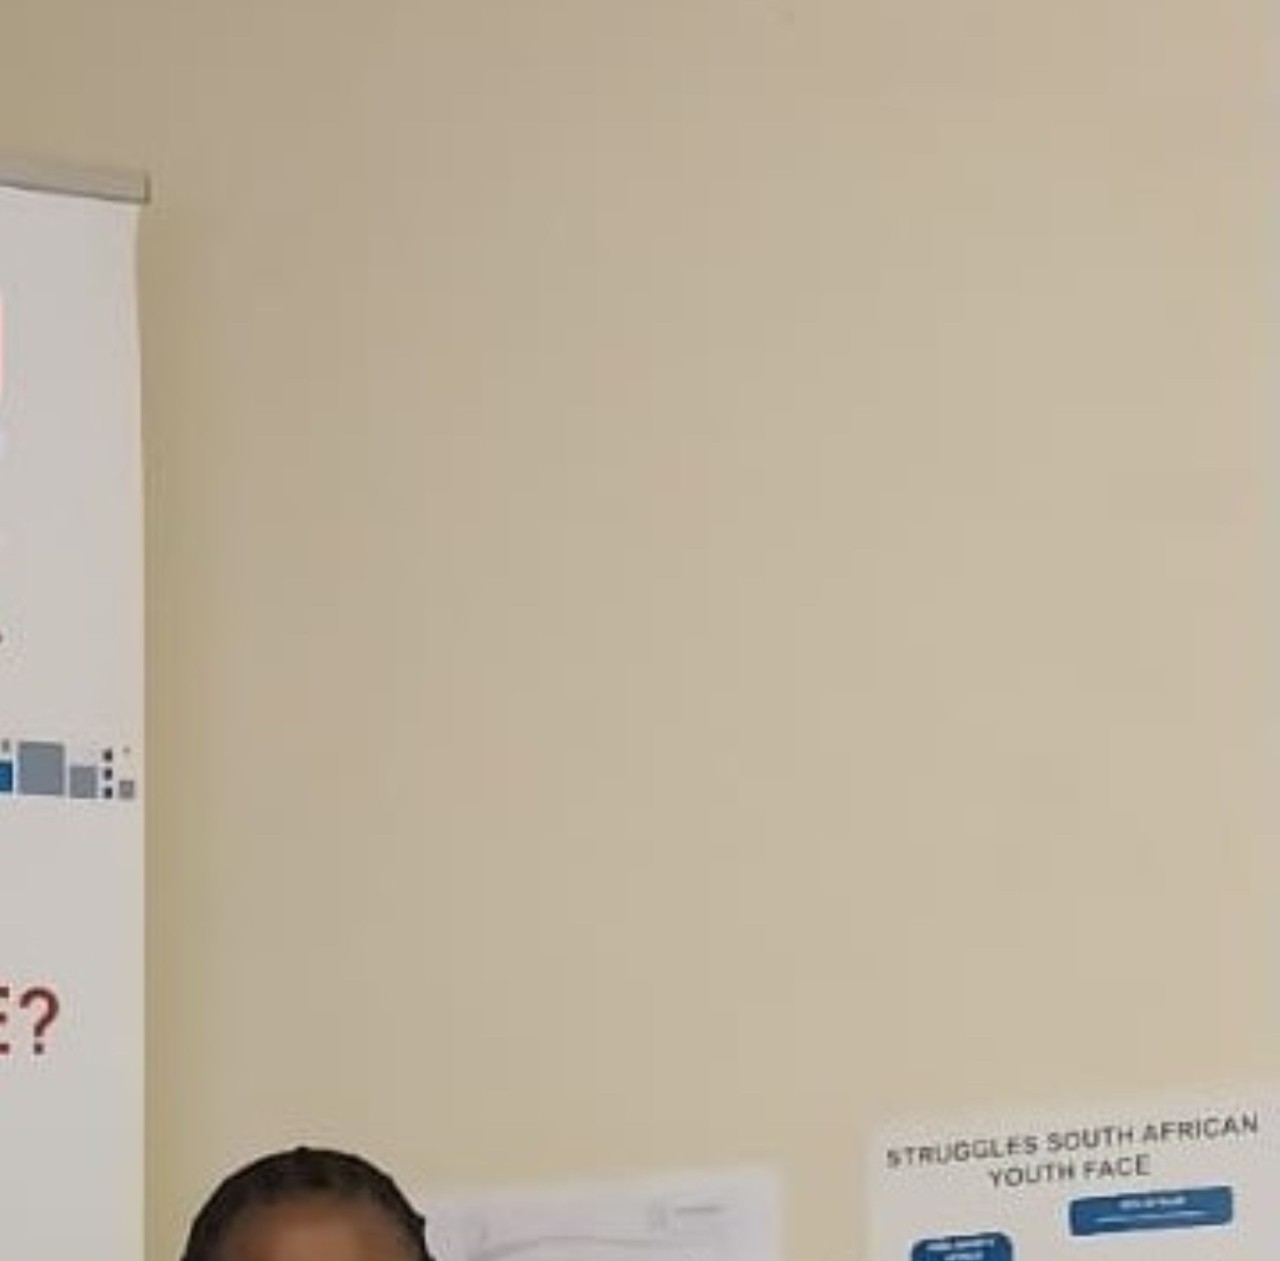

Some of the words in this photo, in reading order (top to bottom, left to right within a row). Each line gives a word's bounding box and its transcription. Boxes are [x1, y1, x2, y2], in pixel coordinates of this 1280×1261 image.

[886, 1134, 1039, 1169] STRUGGLES
[1047, 1124, 1134, 1153] SOUTH
[1141, 1112, 1260, 1144] AFRICAN
[988, 1161, 1075, 1189] YOUTH
[1082, 1153, 1153, 1181] FACE
